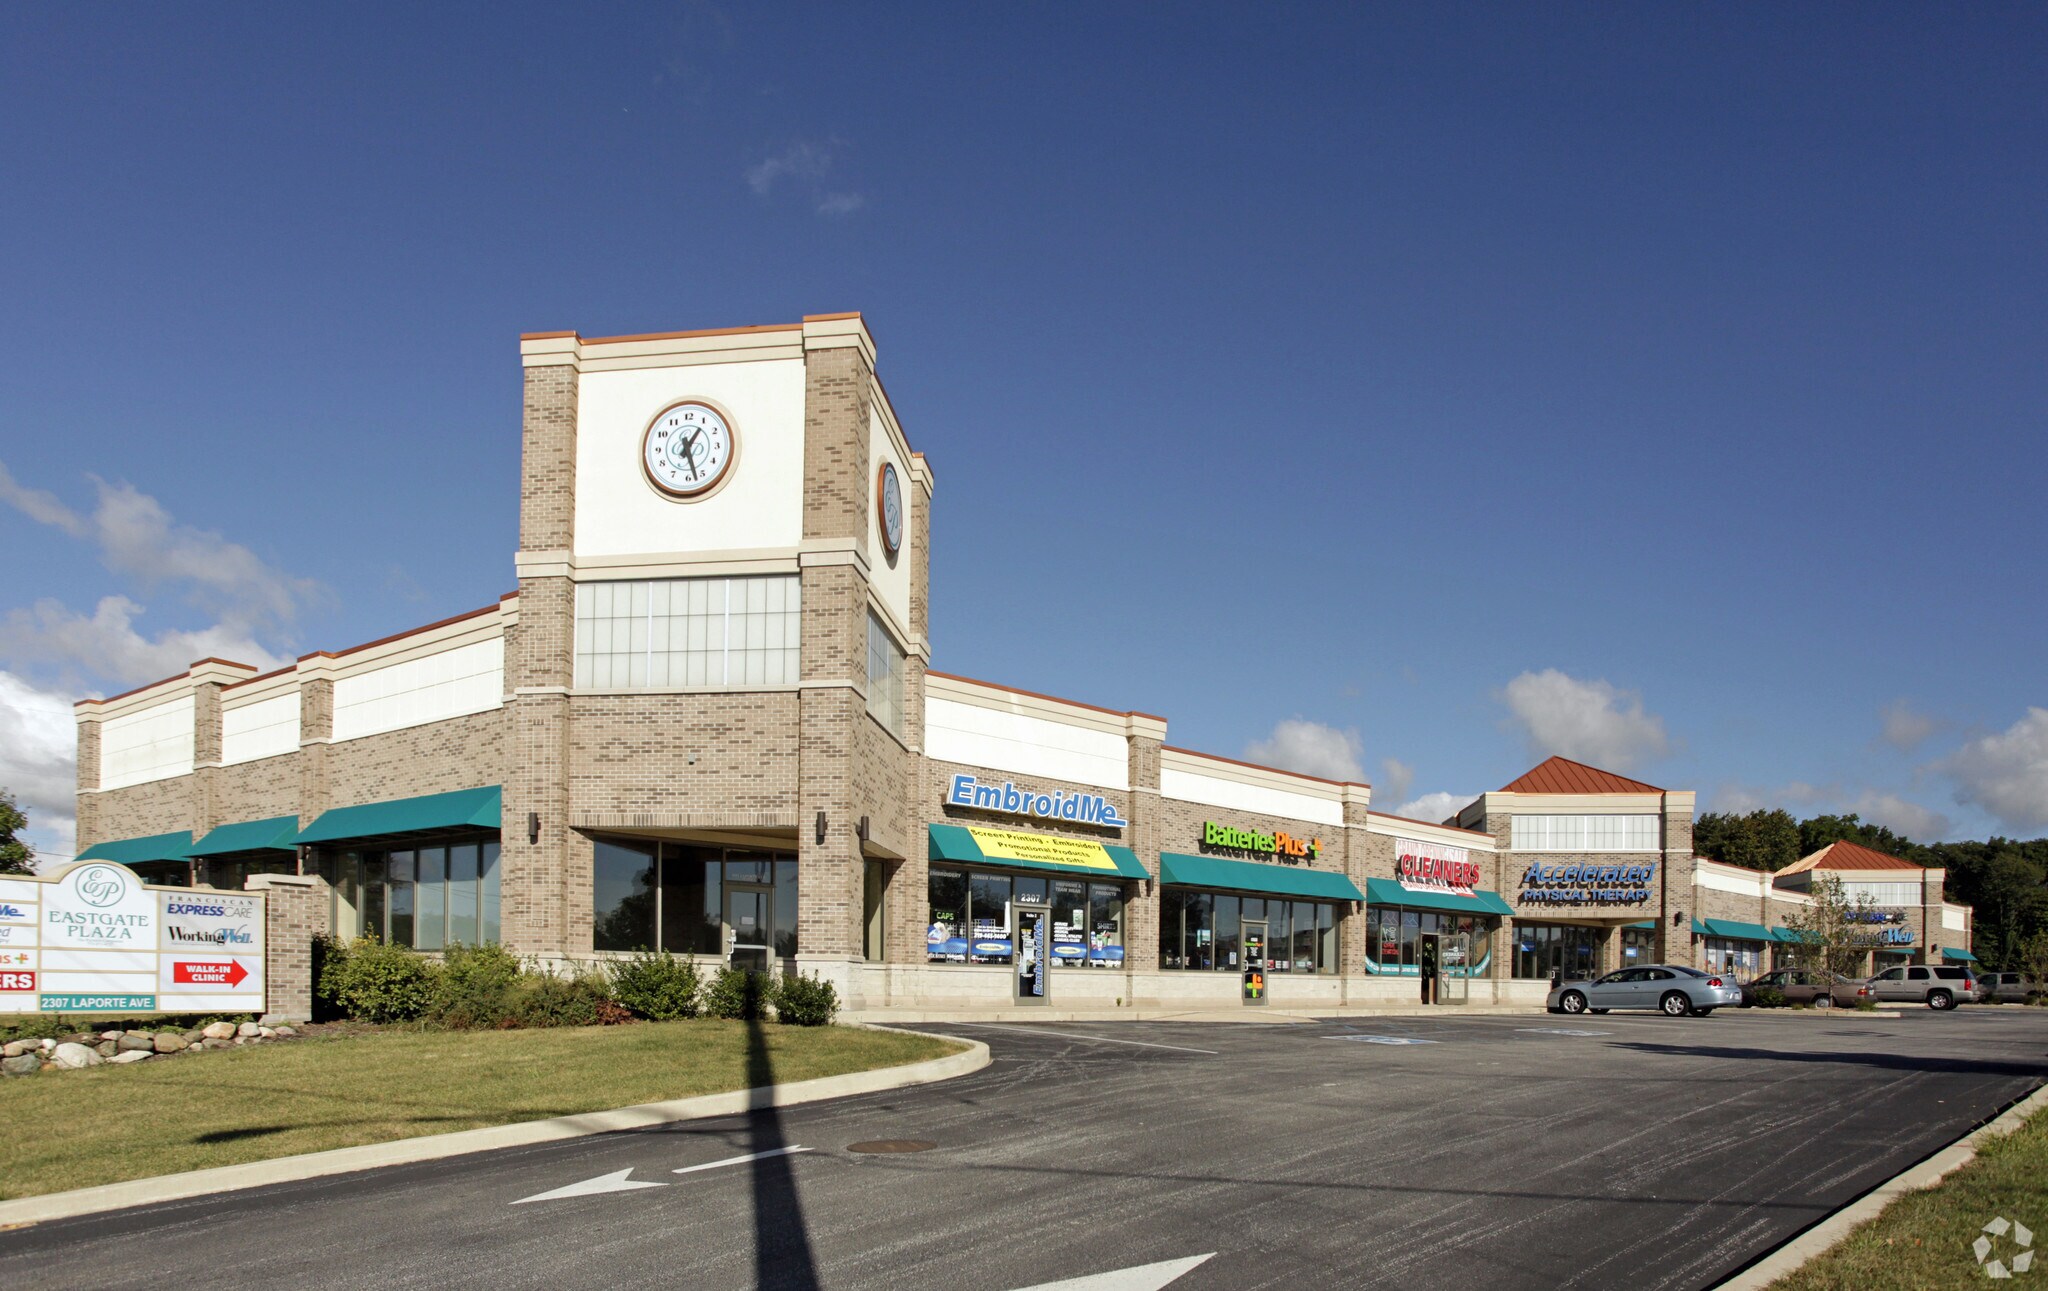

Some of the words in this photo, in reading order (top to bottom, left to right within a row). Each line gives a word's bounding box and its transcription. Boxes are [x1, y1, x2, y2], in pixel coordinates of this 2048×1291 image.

[685, 413, 694, 421] 12
[712, 427, 718, 435] 2
[714, 442, 720, 450] 3
[710, 457, 716, 465] 4
[670, 470, 676, 478] 7
[685, 474, 692, 482] 6
[700, 470, 706, 478] 5
[950, 773, 1128, 828] EmbroidMe
[970, 829, 1004, 838] Screen
[1006, 833, 1044, 844] Printing
[1052, 838, 1101, 851] Embroidery
[997, 841, 1051, 853] Promotional
[1052, 848, 1091, 858] Products
[1015, 851, 1065, 862] Personalized
[1401, 853, 1480, 885] CLEANERS
[1524, 862, 1657, 883] Accelerated
[168, 895, 254, 906] FRANCISCAN
[1020, 893, 1041, 903] 2307
[1524, 889, 1589, 901] PHYSICAL
[1590, 889, 1653, 901] THERAPY
[48, 910, 149, 927] EASTGATE
[936, 911, 955, 920] CAPS
[67, 925, 132, 939] PLAZA
[1032, 913, 1044, 996] EmbroidMe
[185, 965, 231, 973] WALK-IN
[0, 973, 33, 989] RS
[191, 973, 226, 982] CLINIC
[41, 997, 69, 1008] 2307
[71, 997, 127, 1008] LAPORTE
[128, 998, 154, 1008] AVE.
